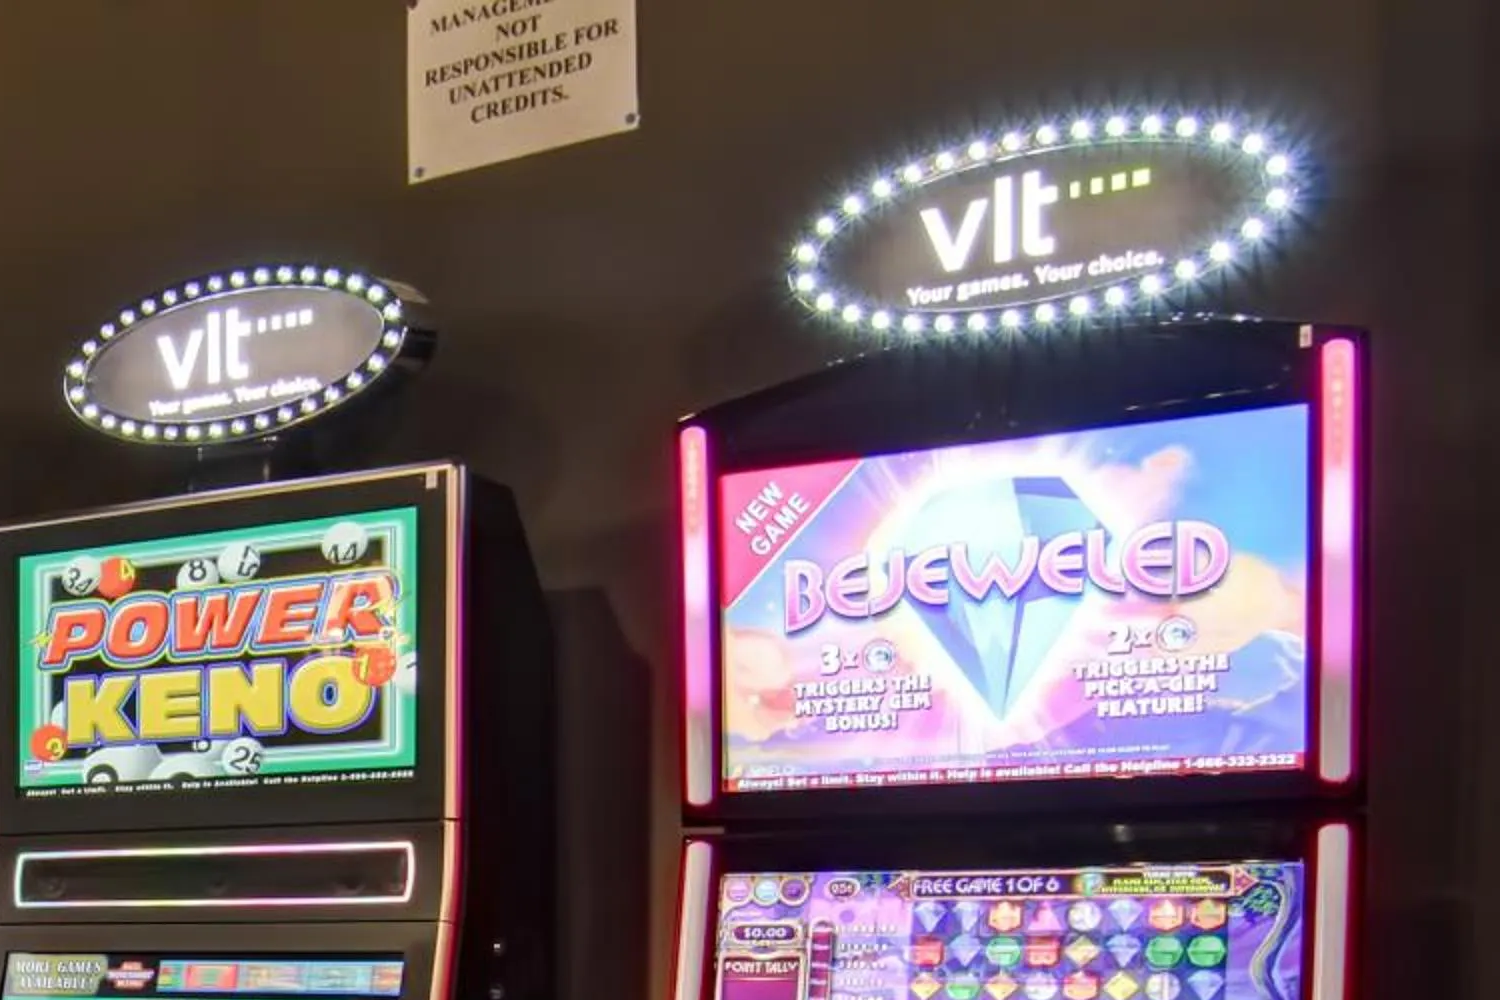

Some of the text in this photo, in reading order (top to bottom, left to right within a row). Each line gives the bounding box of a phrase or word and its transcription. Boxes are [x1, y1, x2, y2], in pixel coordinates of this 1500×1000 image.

[430, 0, 551, 35] MANAGE
[496, 14, 541, 41] NOT
[424, 18, 619, 87] RESPONSIBLE FOR
[448, 52, 593, 105] UNATTENDED
[470, 85, 570, 123] CREDITS.
[920, 171, 1058, 272] vlt
[907, 250, 1164, 306] Your games. Your choice.
[157, 308, 251, 390] vlt
[735, 480, 784, 534] NEW
[750, 493, 810, 556] GAME
[188, 557, 207, 582] 8
[783, 519, 1231, 635] BEJEWELED
[40, 572, 398, 669] POWER
[1073, 653, 1231, 682] TRIGGERS THE
[64, 654, 379, 747] KENO
[793, 674, 932, 701] TRIGGERS THE
[794, 692, 933, 718] MYSTERY GEM
[825, 713, 900, 734] BONUS!
[1096, 694, 1206, 719] FEATURE!
[229, 745, 261, 774] 25
[913, 876, 1060, 894] FREE GAME 1 OF 6
[743, 927, 788, 939] $0.00
[725, 960, 799, 974] POINT TALLY
